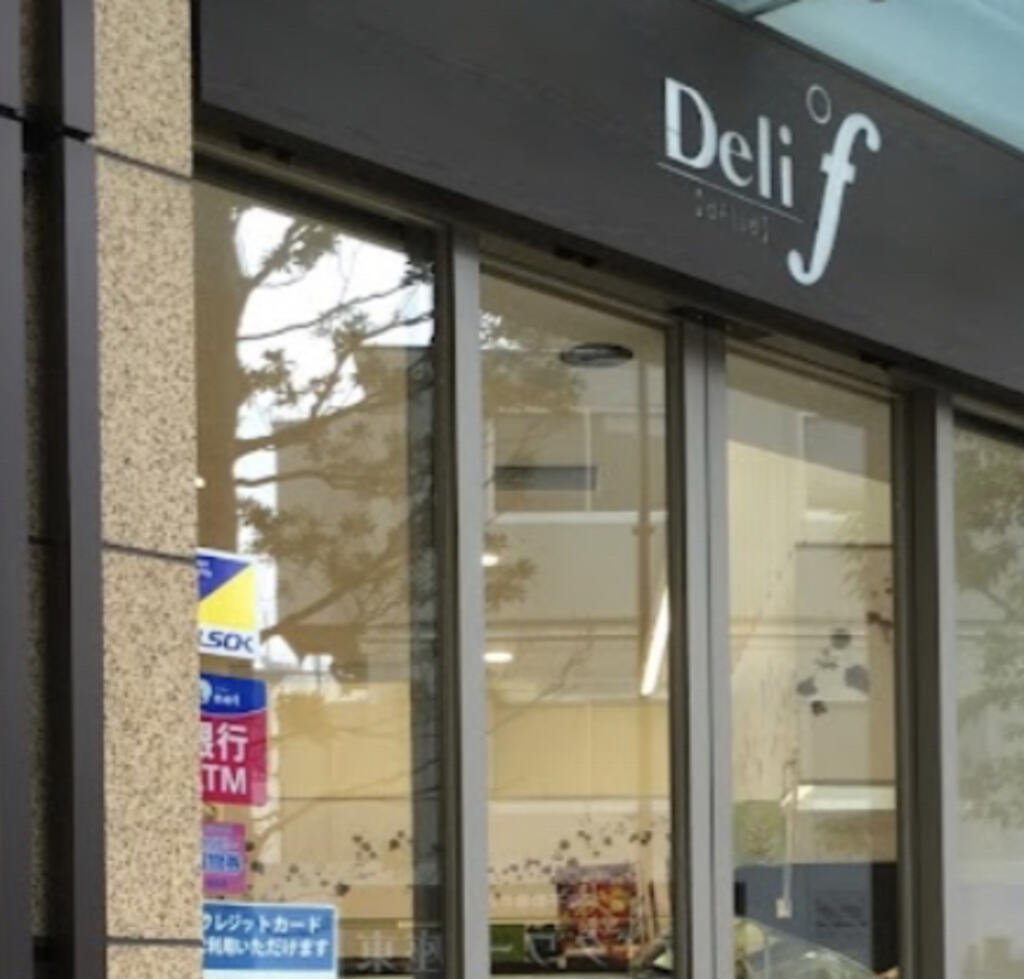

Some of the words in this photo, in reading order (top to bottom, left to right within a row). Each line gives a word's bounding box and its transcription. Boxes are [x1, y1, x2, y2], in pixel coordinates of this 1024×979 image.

[664, 77, 794, 208] Deli
[786, 112, 881, 286] f
[199, 630, 254, 654] LSOK
[201, 762, 248, 795] TM
[205, 935, 330, 958] 利用いただけます
